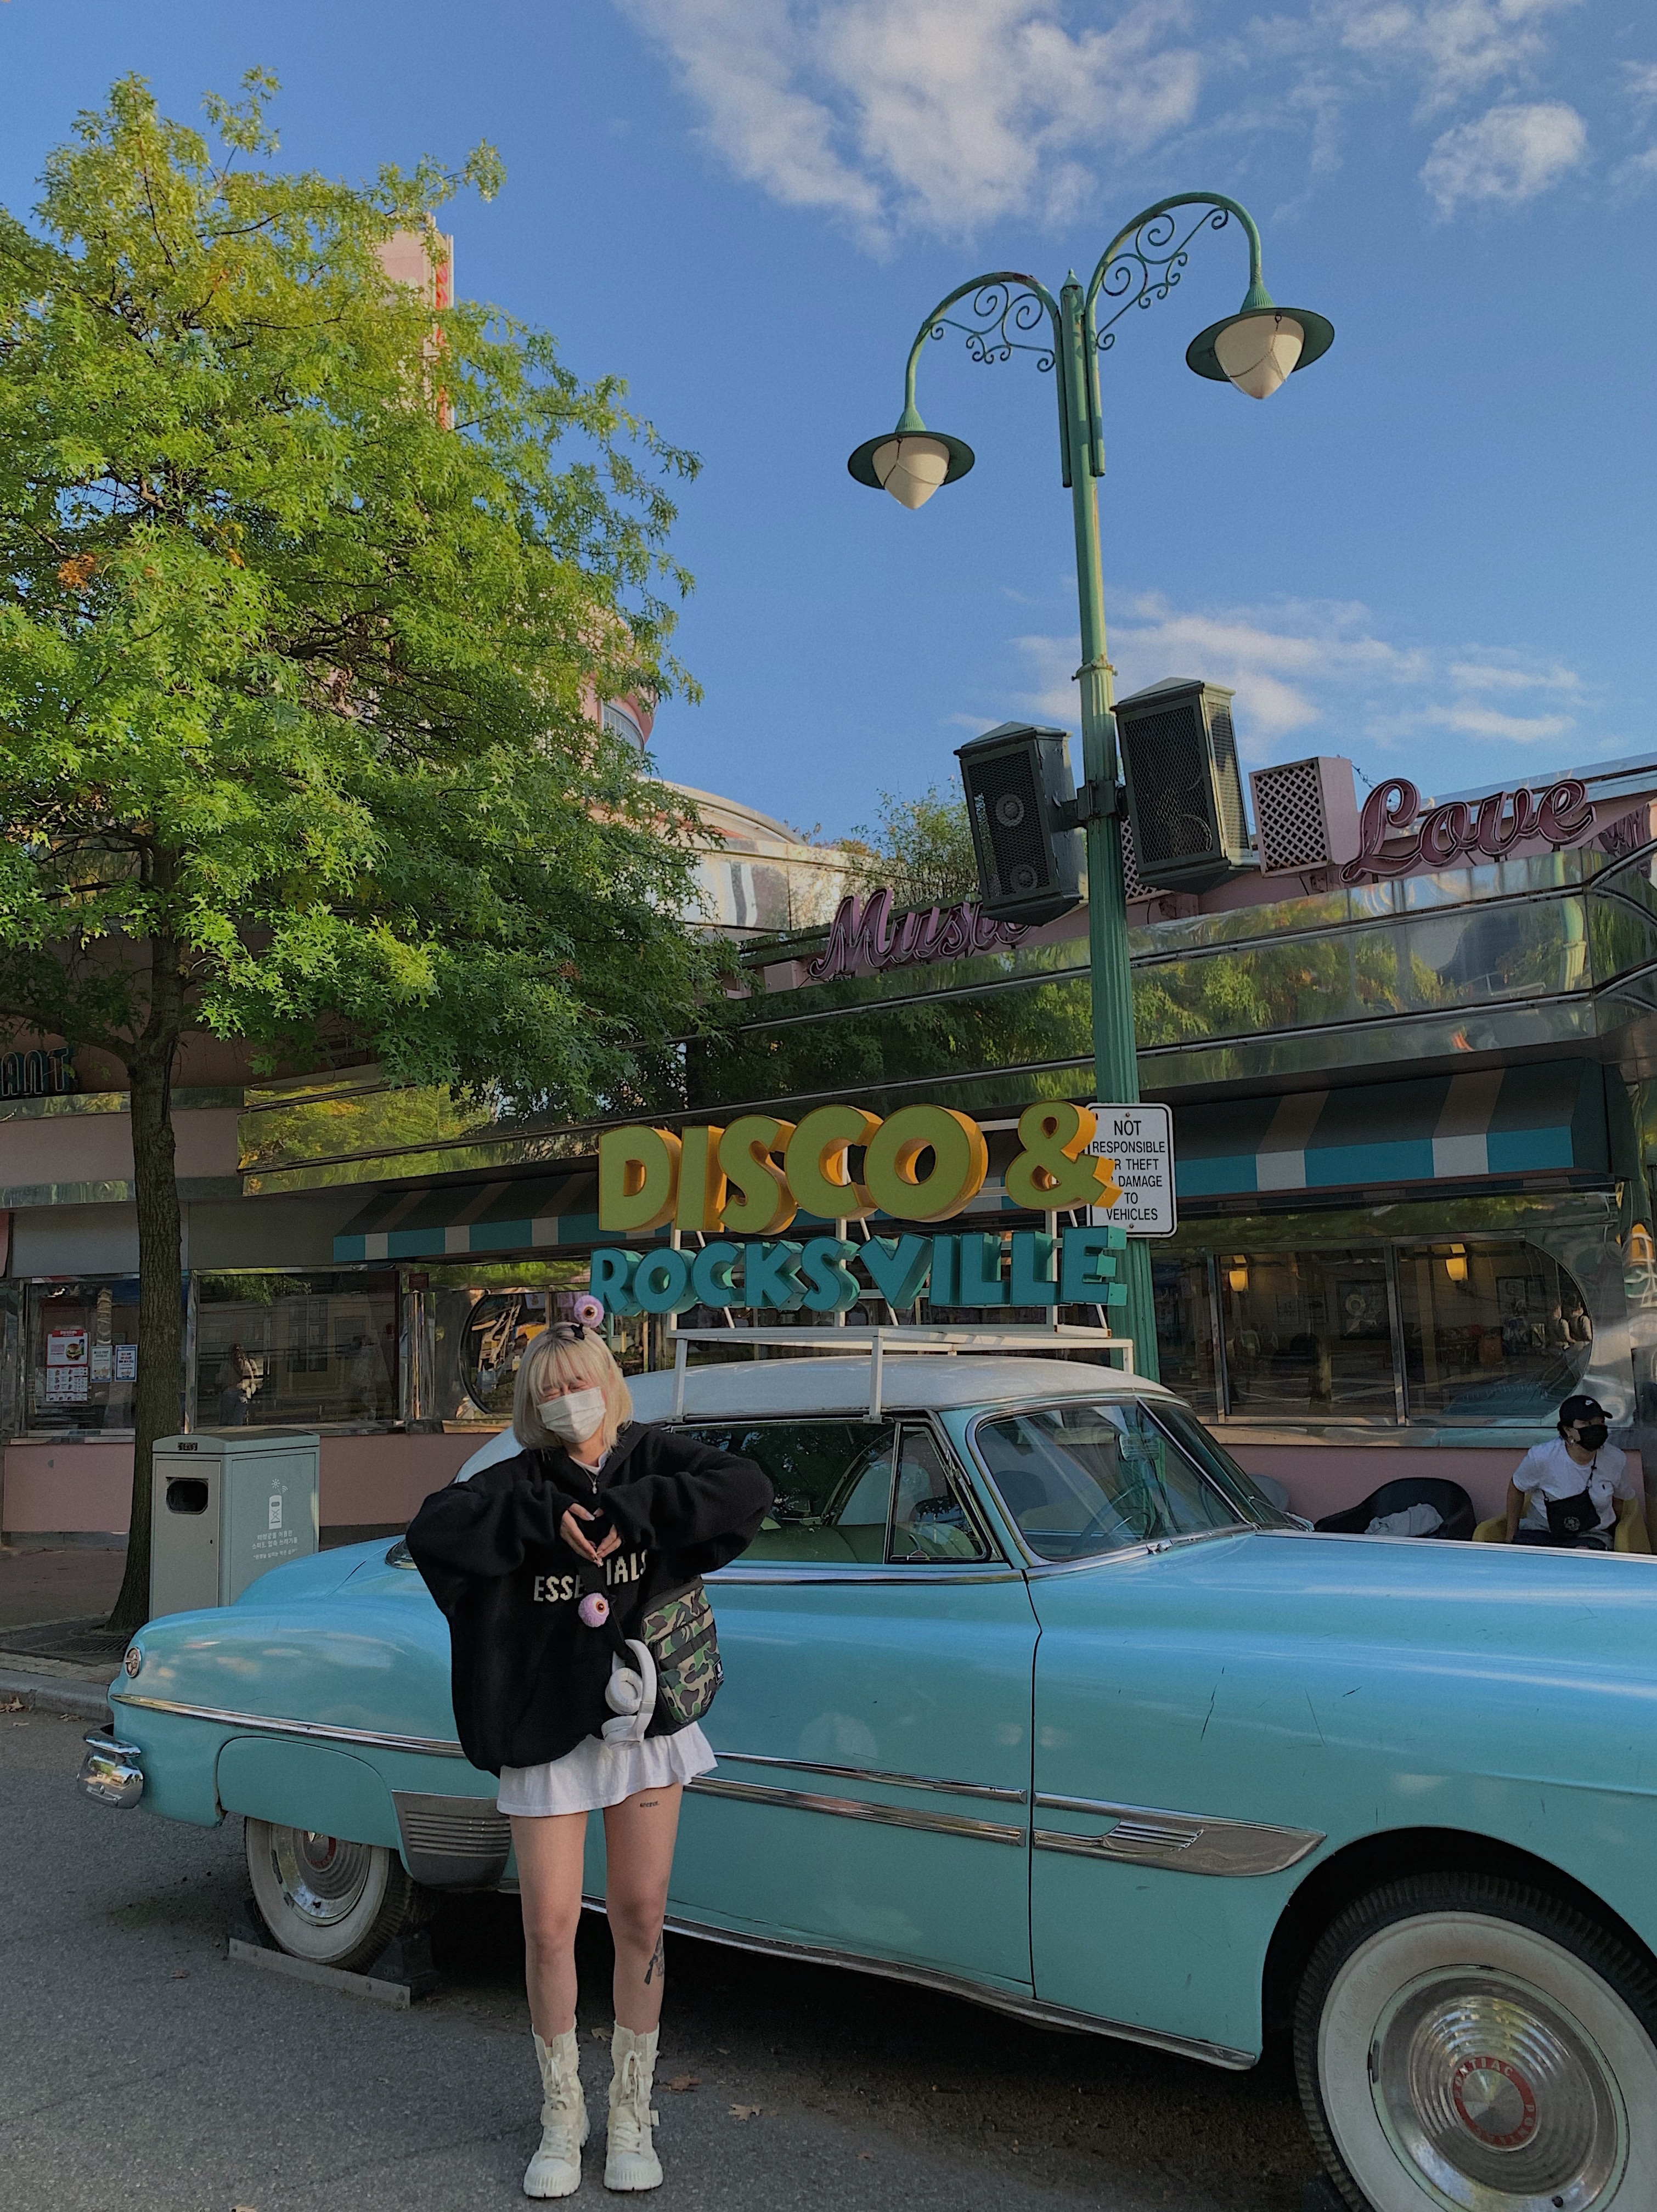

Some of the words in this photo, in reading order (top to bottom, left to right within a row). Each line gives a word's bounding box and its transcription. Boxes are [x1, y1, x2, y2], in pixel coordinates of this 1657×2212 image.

[1340, 778, 1597, 883] Love
[807, 888, 1033, 982] Musi
[1114, 1120, 1142, 1136] NOT
[1092, 1141, 1165, 1153] RESPONSIBLE
[599, 1104, 988, 1234] DISCO
[1005, 1100, 1123, 1210] &
[1126, 1159, 1159, 1170] THEFT
[1118, 1176, 1163, 1187] DAMAGE
[1124, 1192, 1139, 1204] TO
[1106, 1208, 1158, 1220] VEHICLES
[590, 1225, 1128, 1317] ROCKSVILLE
[533, 1549, 649, 1602] ESSEIALS
[1453, 2057, 1513, 2100] PONTIAC
